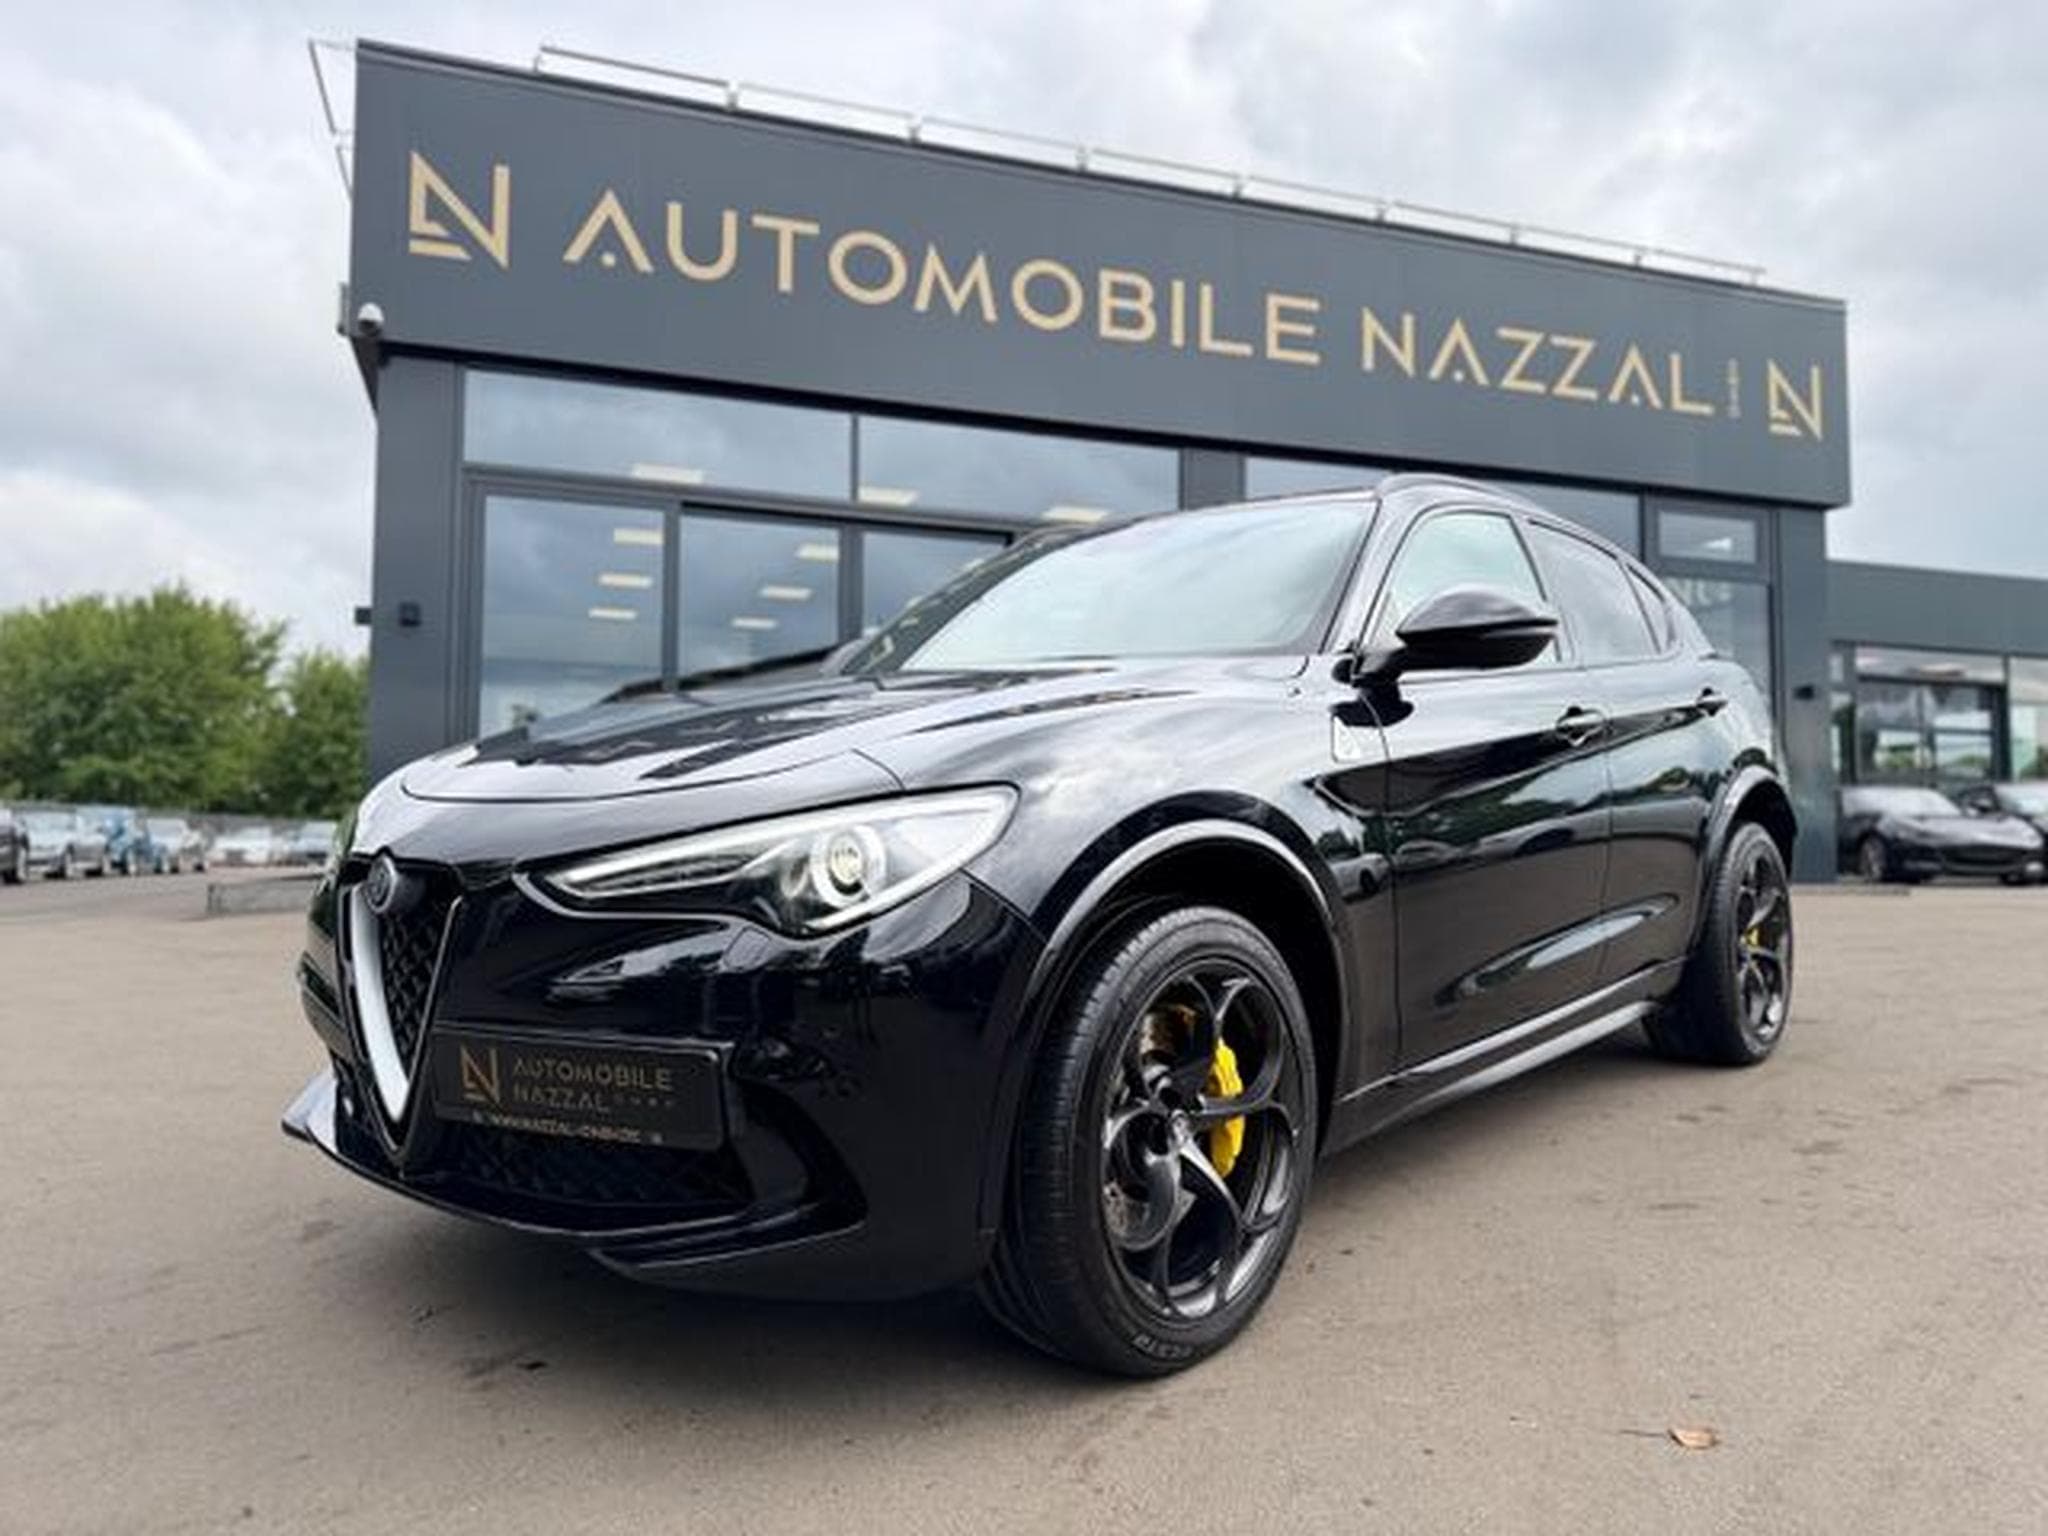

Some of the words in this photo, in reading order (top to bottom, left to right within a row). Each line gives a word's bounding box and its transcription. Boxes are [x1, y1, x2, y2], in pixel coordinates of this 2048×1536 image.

[563, 189, 1320, 365] AUTOMOBILE
[1362, 307, 1714, 415] NAZZAL
[513, 1057, 674, 1092] AUTOMOBILE
[513, 1083, 610, 1113] NAZZAL
